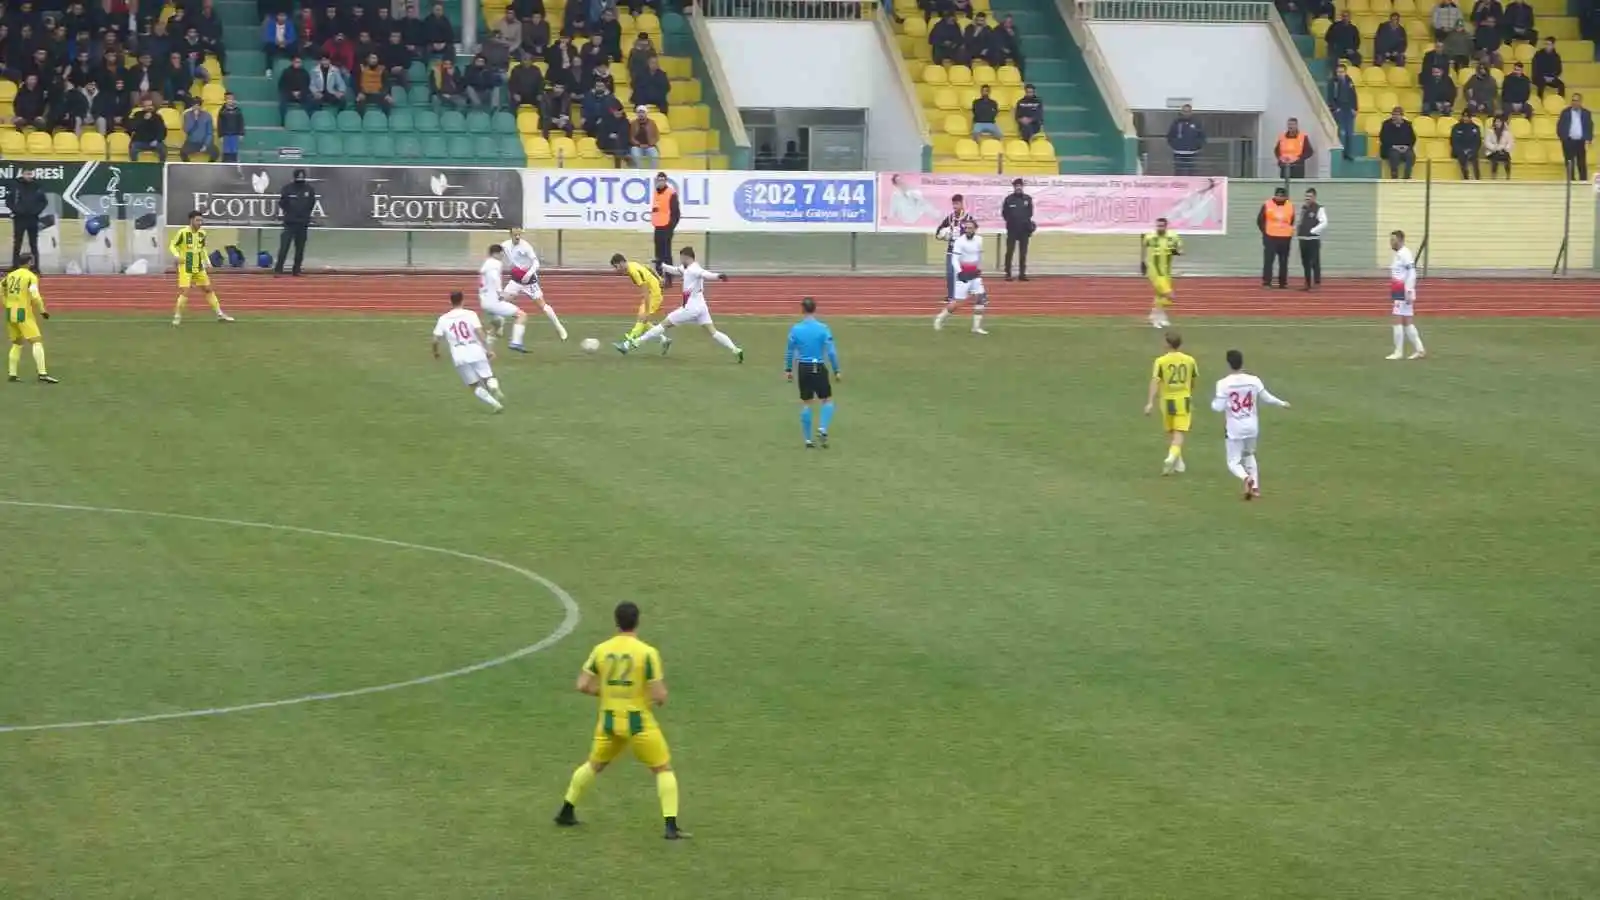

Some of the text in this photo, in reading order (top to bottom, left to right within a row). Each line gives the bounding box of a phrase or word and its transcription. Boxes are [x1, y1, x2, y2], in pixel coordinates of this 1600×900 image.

[544, 175, 709, 205] KATALI
[753, 183, 796, 204] 202
[802, 183, 816, 204] 7
[822, 183, 866, 205] 444
[370, 194, 504, 219] ECOTURCA
[450, 320, 472, 341] 10
[1167, 363, 1188, 385] 20
[1229, 390, 1254, 413] 34
[605, 653, 634, 687] 22
